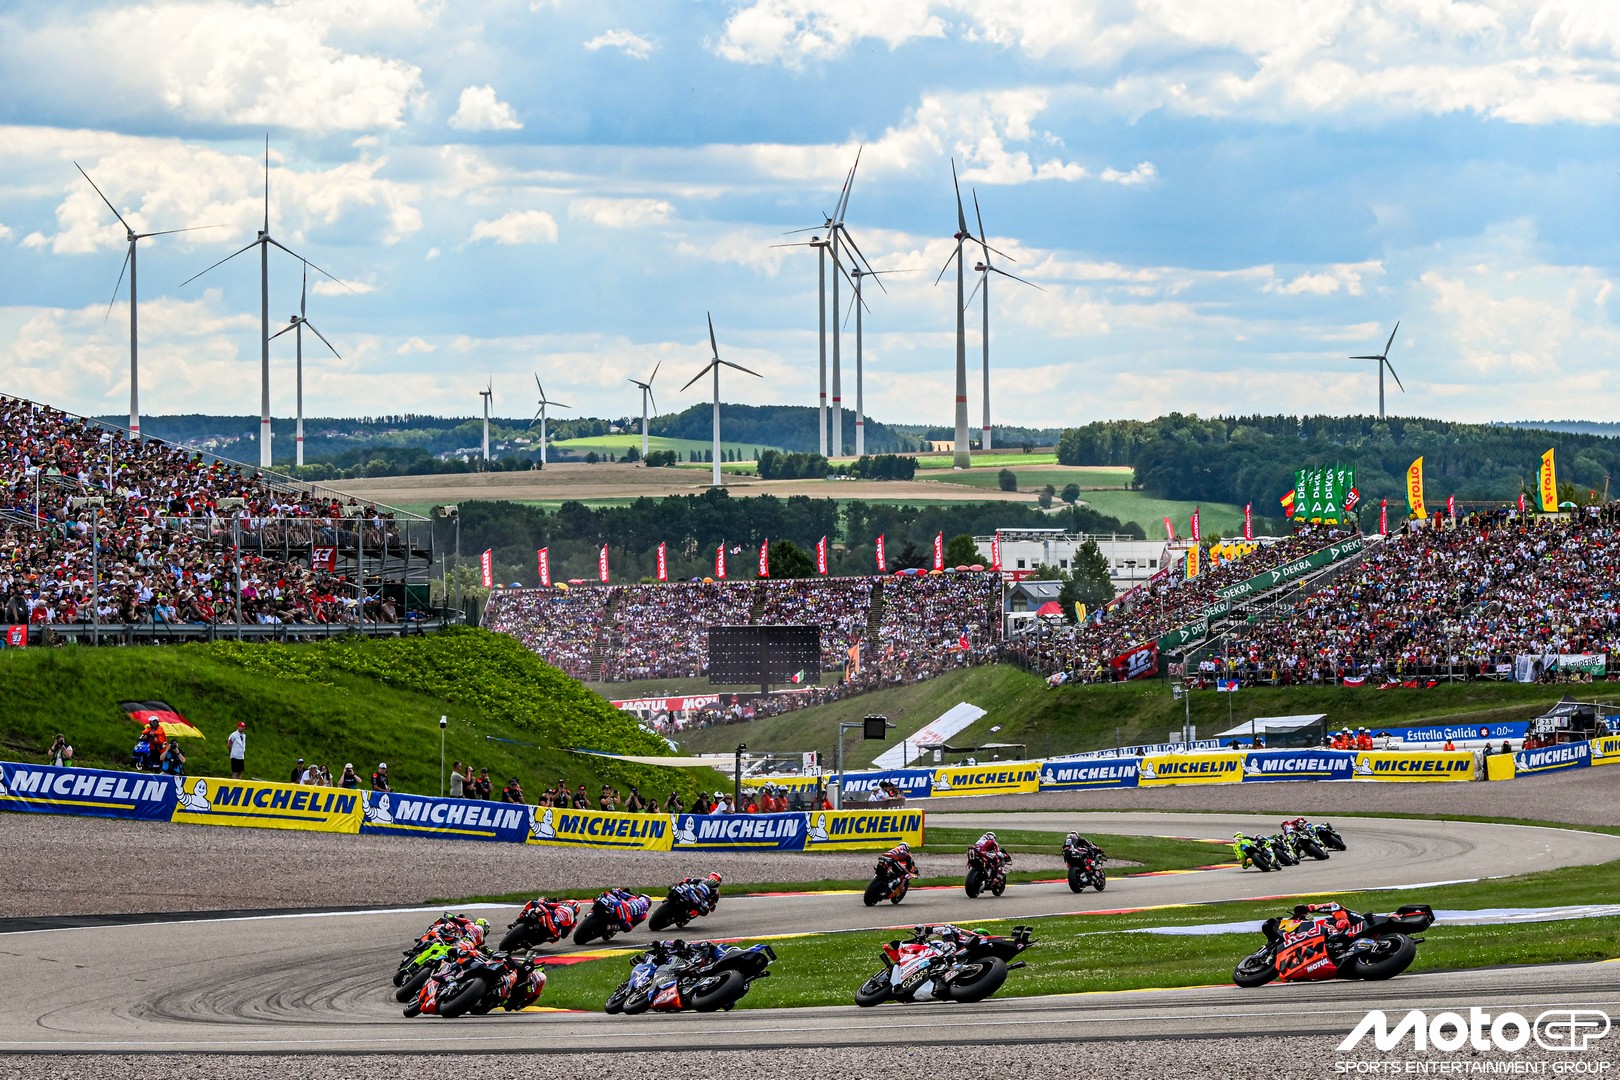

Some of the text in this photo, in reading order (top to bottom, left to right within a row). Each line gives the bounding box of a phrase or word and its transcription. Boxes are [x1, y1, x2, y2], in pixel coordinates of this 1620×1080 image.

[1282, 560, 1312, 576] DEKRA
[1223, 583, 1253, 599] DEKRA
[1127, 649, 1151, 670] 12
[621, 699, 668, 711] MOTUL
[1406, 729, 1443, 741] Estrella
[1444, 727, 1477, 741] Galicia
[1528, 744, 1588, 767] MICHELIN
[1057, 764, 1137, 780] MICHELIN
[1158, 759, 1238, 775] MICHELIN
[1262, 758, 1349, 772] MICHELIN
[1373, 760, 1471, 772] MICHELIN
[10, 770, 169, 801] MICHELIN
[952, 769, 1039, 787] MICHELIN
[214, 786, 358, 814] MICHELIN
[395, 800, 523, 829] MICHELIN
[557, 814, 667, 839] MICHELIN
[699, 813, 799, 838] MICHELIN
[829, 815, 921, 834] MICHELIN
[1279, 941, 1325, 974] KTM
[1306, 957, 1330, 973] MOTUL
